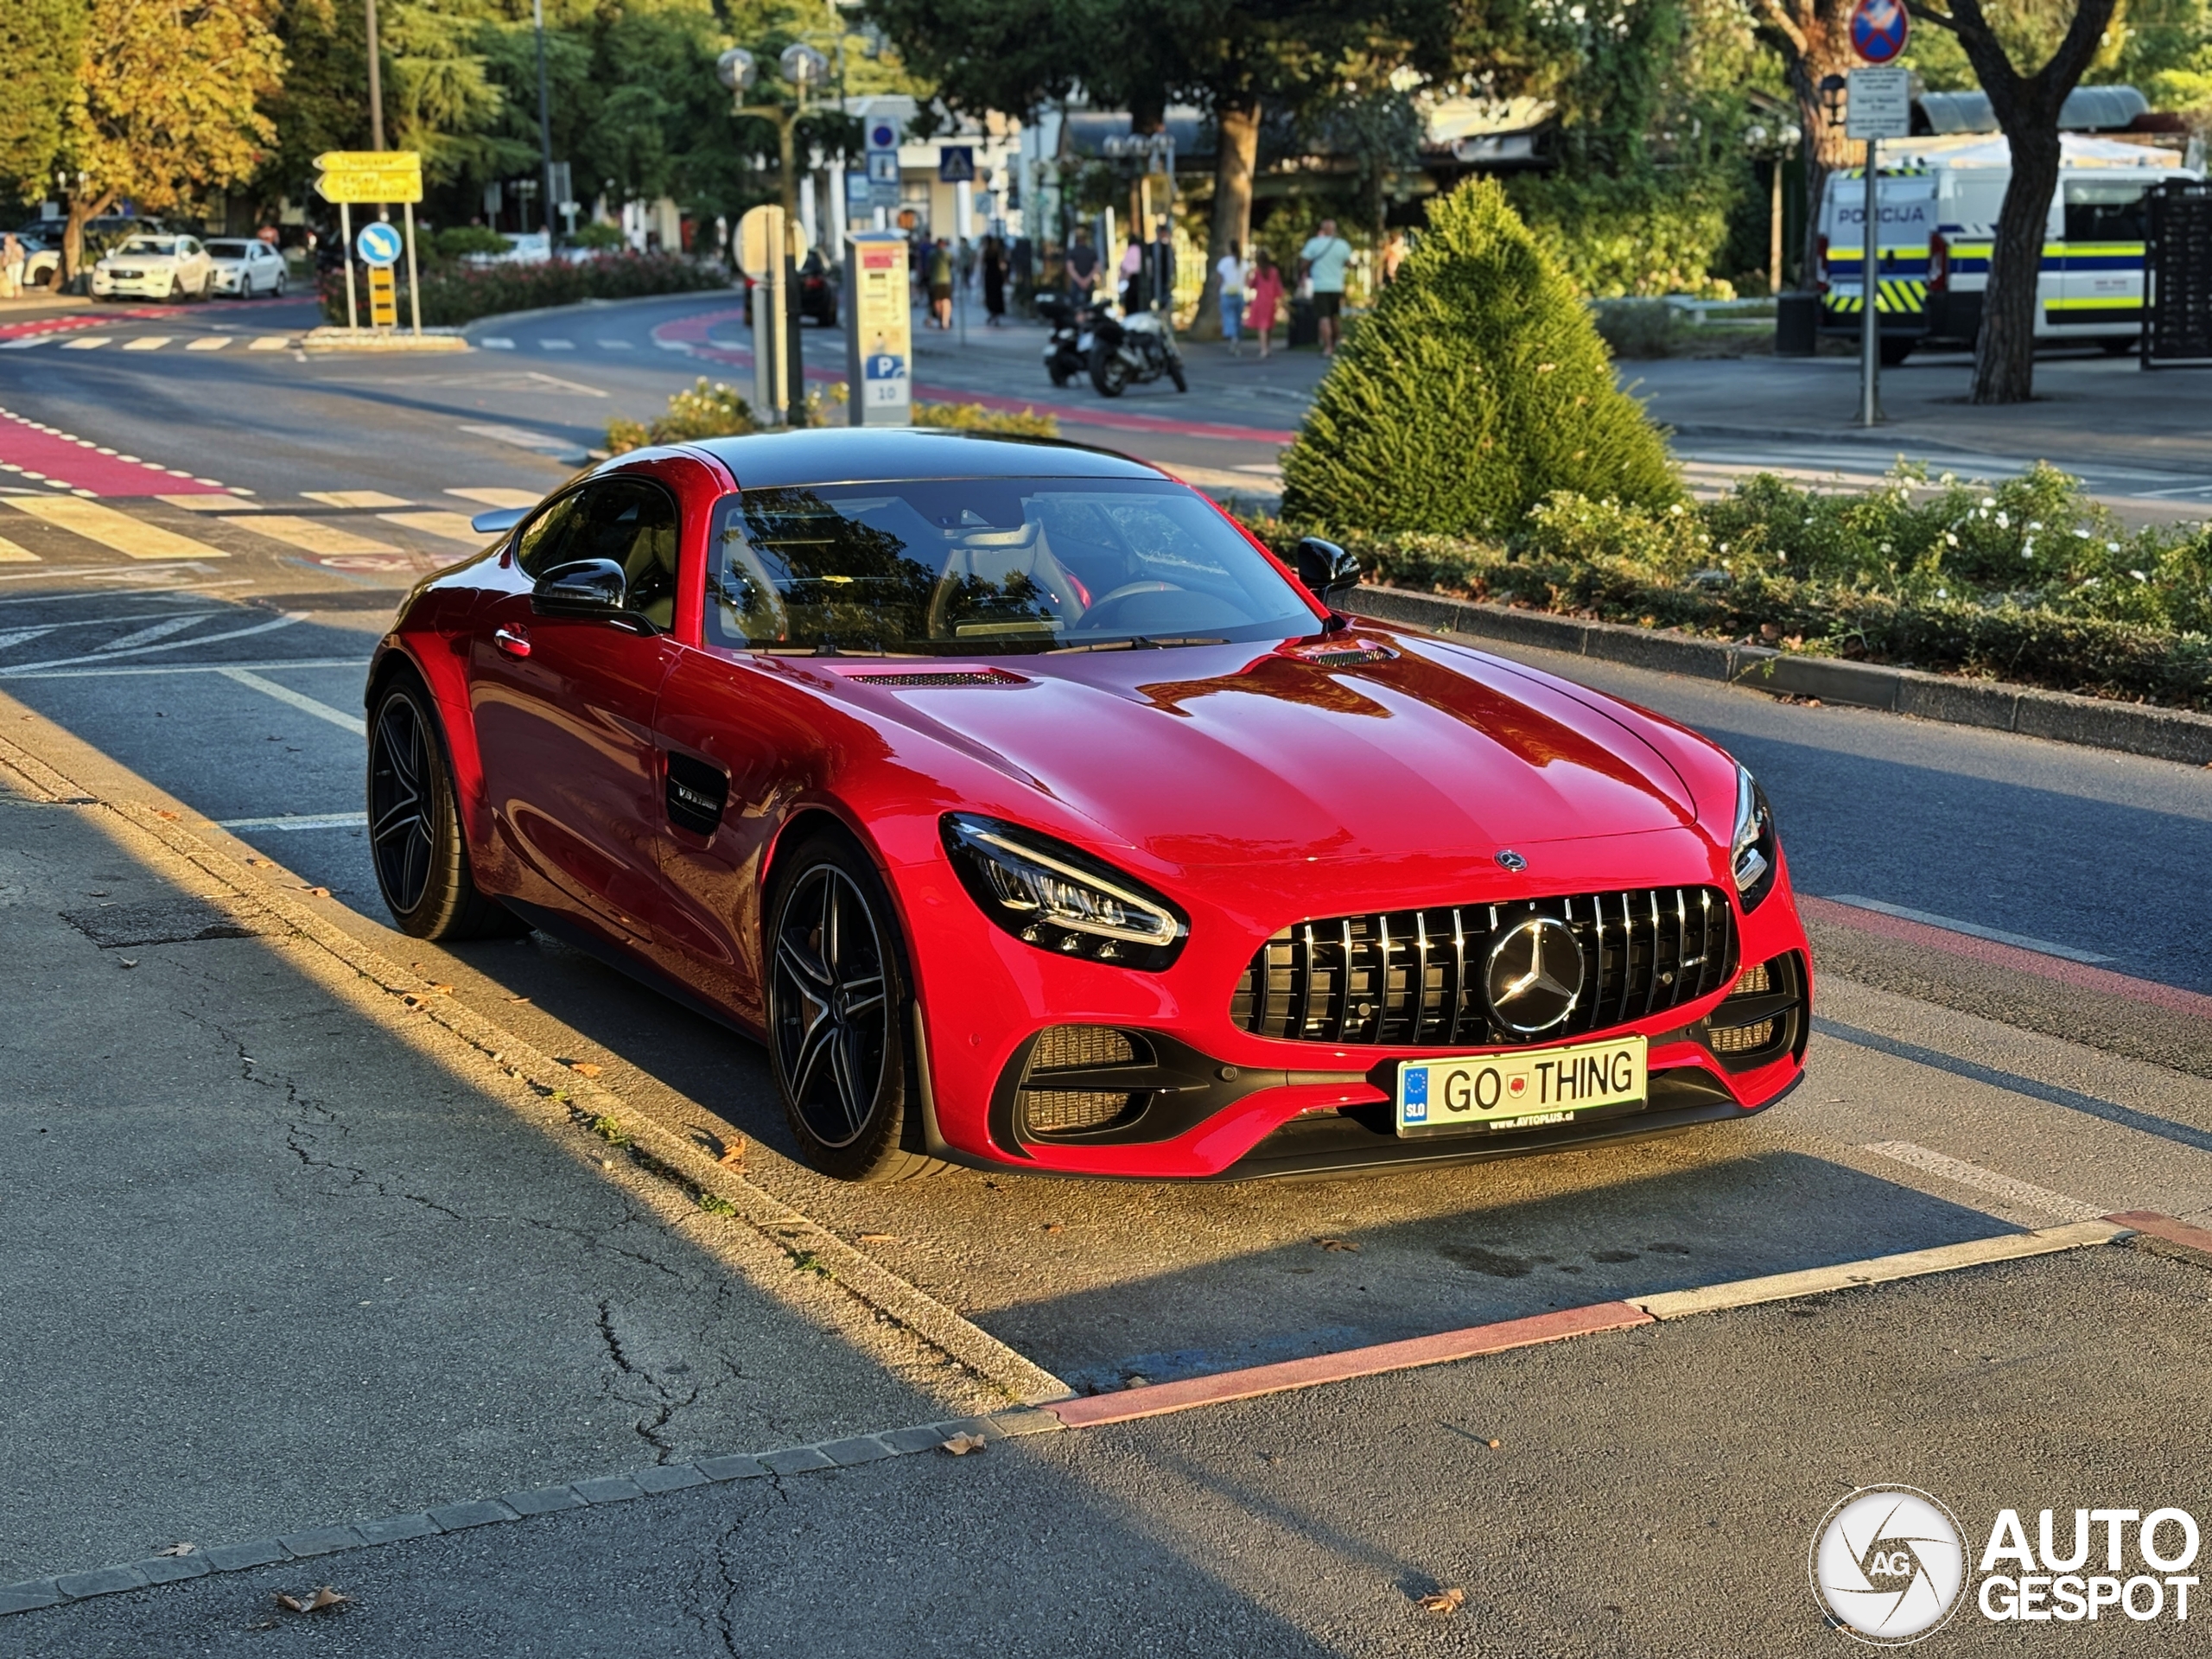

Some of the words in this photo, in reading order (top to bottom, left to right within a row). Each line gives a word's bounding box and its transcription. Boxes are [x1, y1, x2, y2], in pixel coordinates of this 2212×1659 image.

[1838, 207, 1925, 225] POICIJA
[878, 355, 893, 378] P
[879, 386, 896, 400] 10
[679, 787, 692, 800] V8
[1444, 1067, 1502, 1112] GO
[1535, 1051, 1631, 1104] THING
[1406, 1103, 1425, 1117] SLO
[1489, 1111, 1574, 1129] www.AVTOPLUS.si
